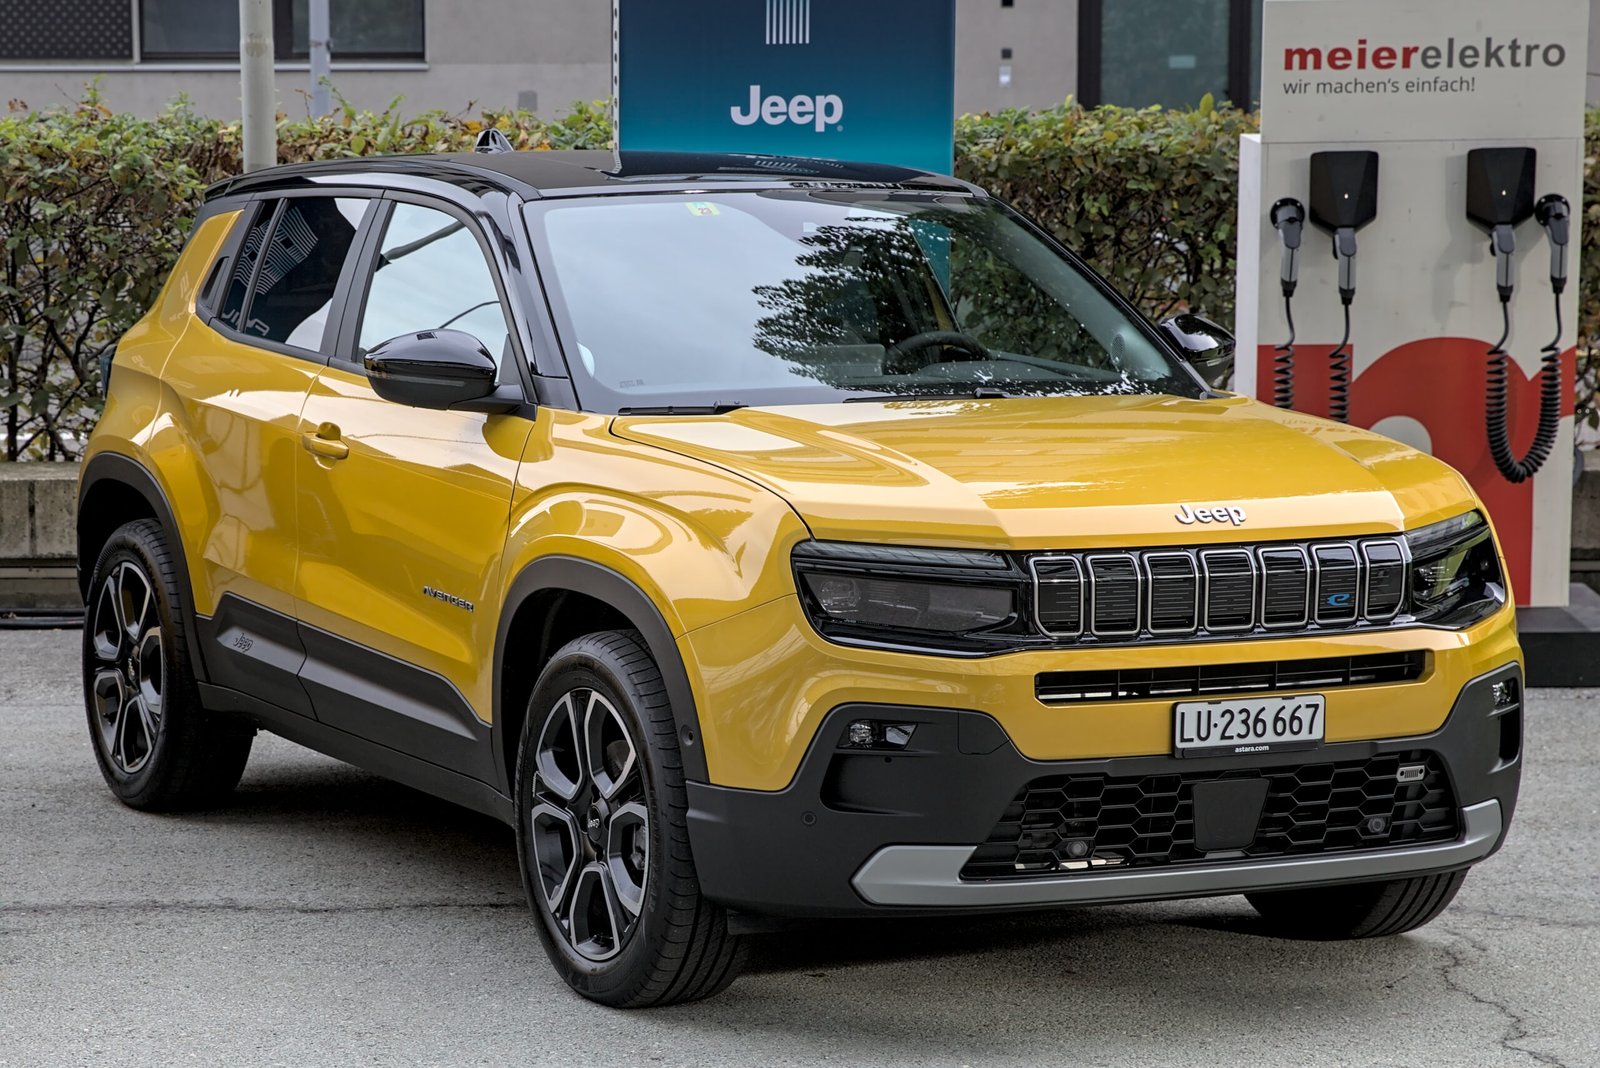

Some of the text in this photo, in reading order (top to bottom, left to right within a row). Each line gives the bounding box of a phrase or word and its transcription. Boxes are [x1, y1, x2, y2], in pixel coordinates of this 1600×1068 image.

[1284, 37, 1566, 70] meierelektro
[1283, 79, 1311, 94] wir
[1405, 76, 1475, 93] einfach!
[730, 85, 844, 132] Jeep
[1175, 504, 1247, 526] Jeep
[423, 585, 474, 613] AVENGER
[1234, 744, 1270, 753] astara.com
